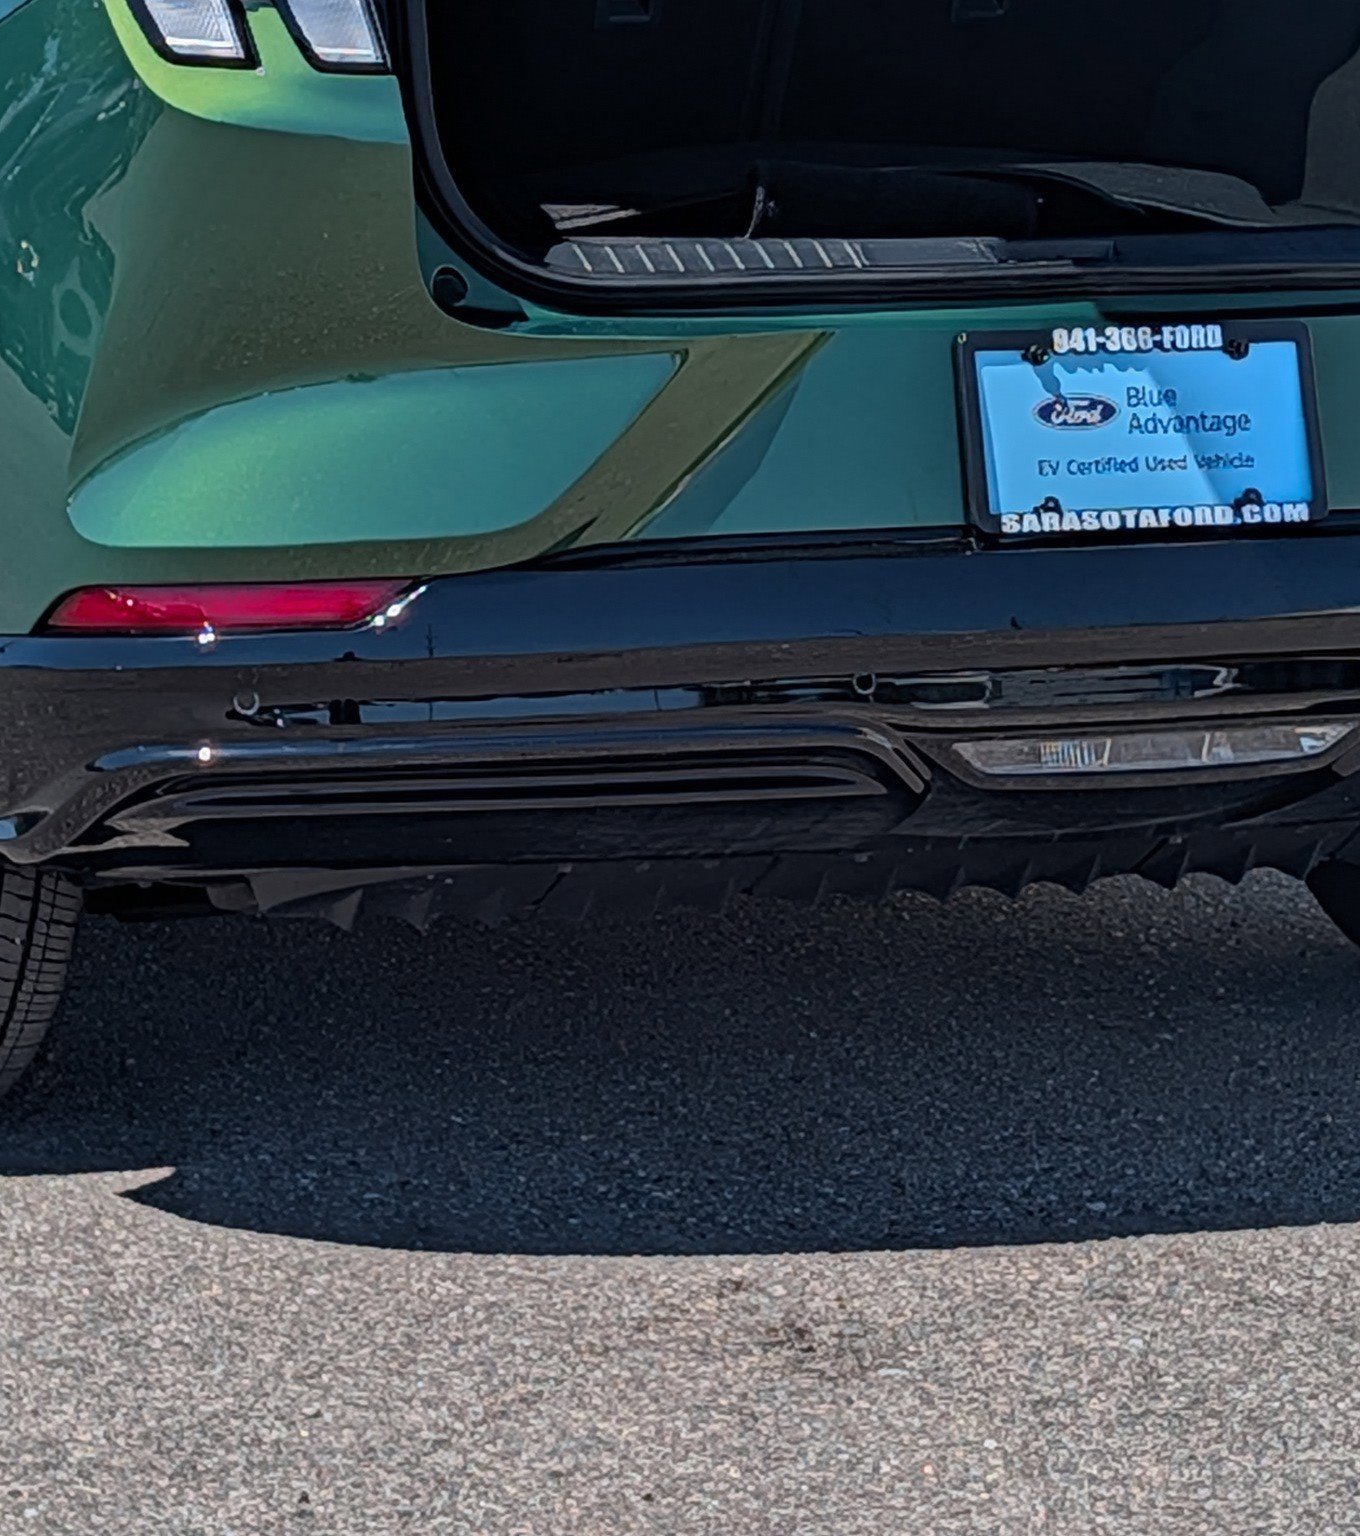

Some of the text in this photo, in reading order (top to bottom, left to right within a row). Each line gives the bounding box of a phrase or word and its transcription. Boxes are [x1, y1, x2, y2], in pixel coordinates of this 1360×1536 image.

[1126, 386, 1177, 408] Blue
[1128, 411, 1252, 437] Advantage
[1037, 459, 1060, 477] EV
[1066, 456, 1139, 476] Certified
[1144, 454, 1188, 473] Used
[1000, 502, 1310, 534] SARASOTAFORD.COM
